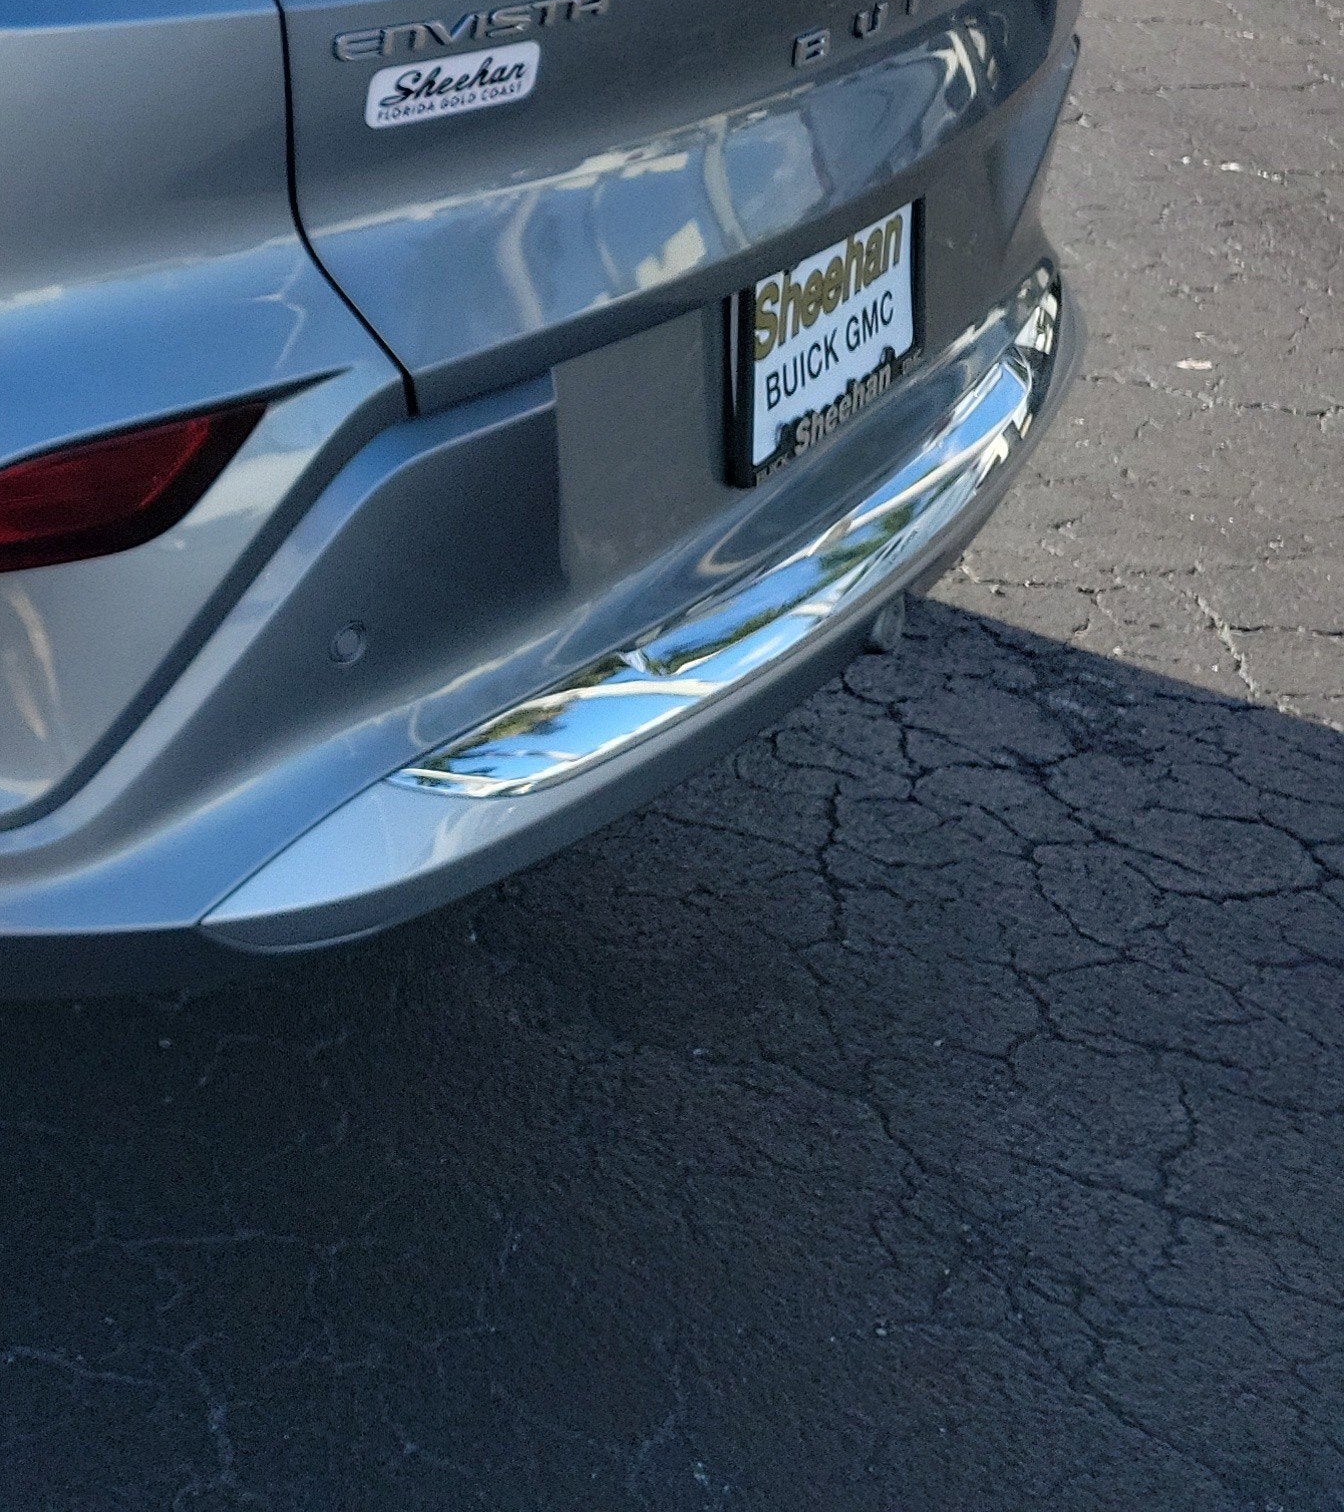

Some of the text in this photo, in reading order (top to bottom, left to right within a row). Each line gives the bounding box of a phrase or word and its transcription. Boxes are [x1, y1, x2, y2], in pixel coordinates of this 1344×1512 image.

[377, 81, 522, 122] FLORIDA GOLD COAST
[379, 56, 526, 107] Sheehan
[754, 213, 904, 361] Sheehan
[766, 290, 894, 411] BUICK GMC
[794, 364, 892, 455] Sheehan
